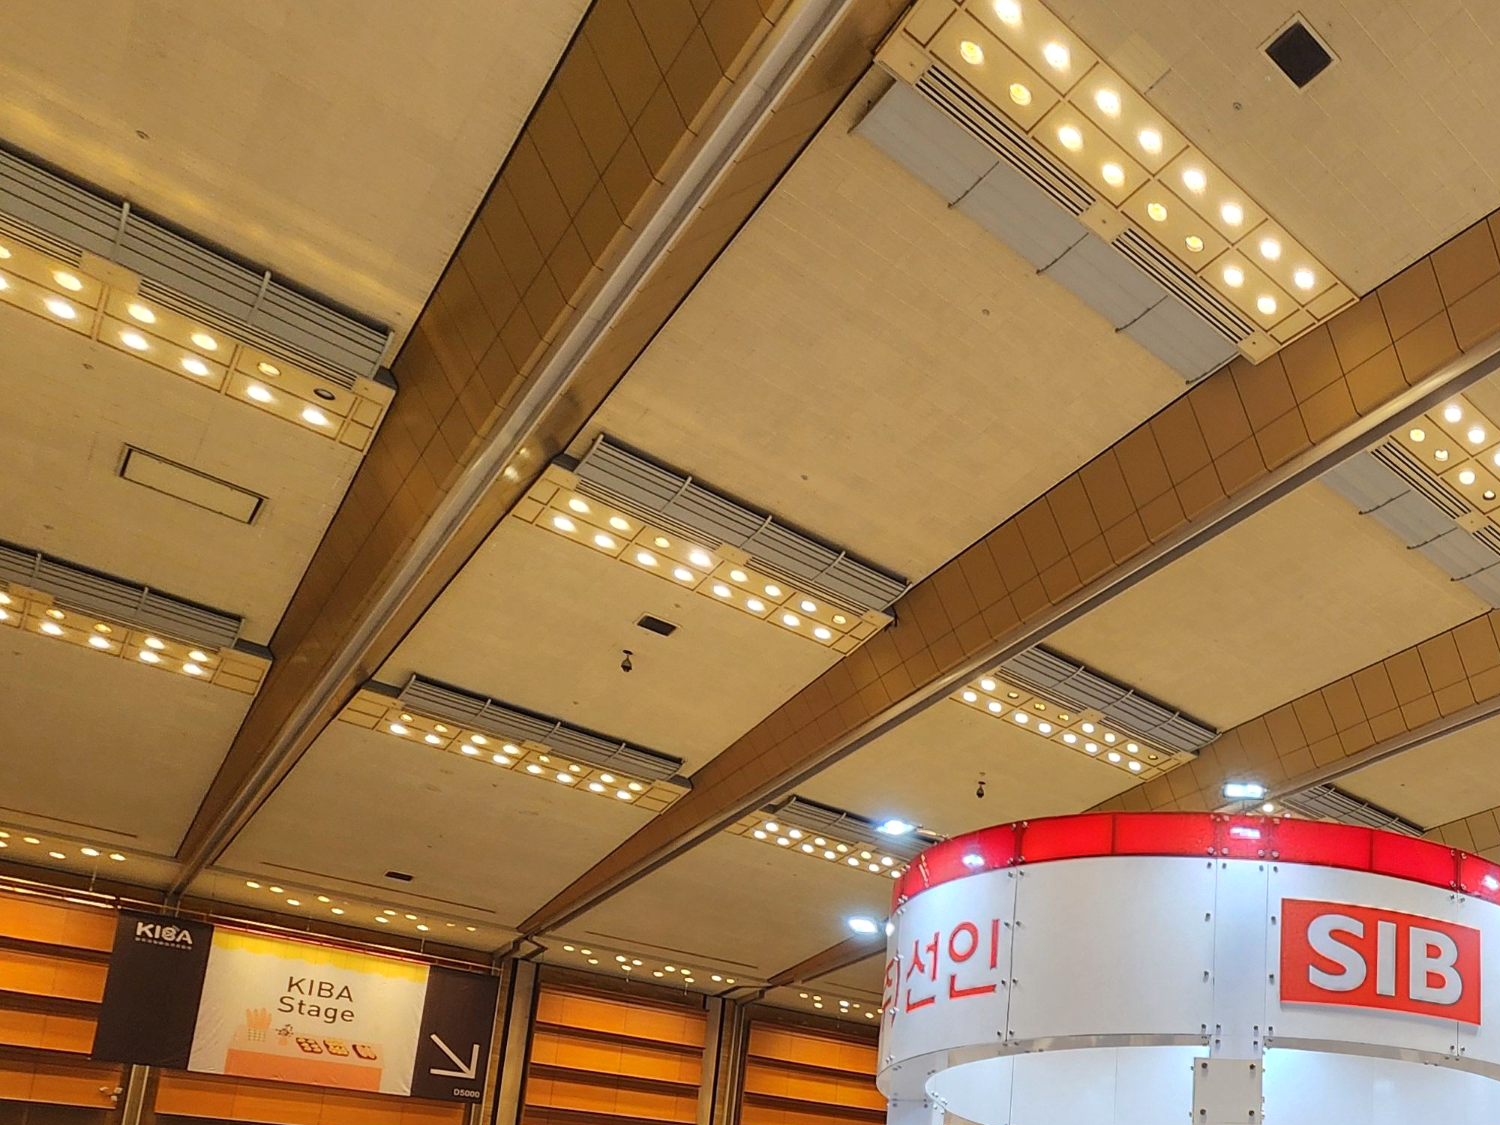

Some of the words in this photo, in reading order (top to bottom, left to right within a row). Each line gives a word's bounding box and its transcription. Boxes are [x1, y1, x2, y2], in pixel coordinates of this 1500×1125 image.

[1306, 913, 1464, 1006] SIB
[287, 976, 354, 1003] KIBA
[277, 996, 355, 1024] Stage
[453, 1087, 481, 1099] D5000
